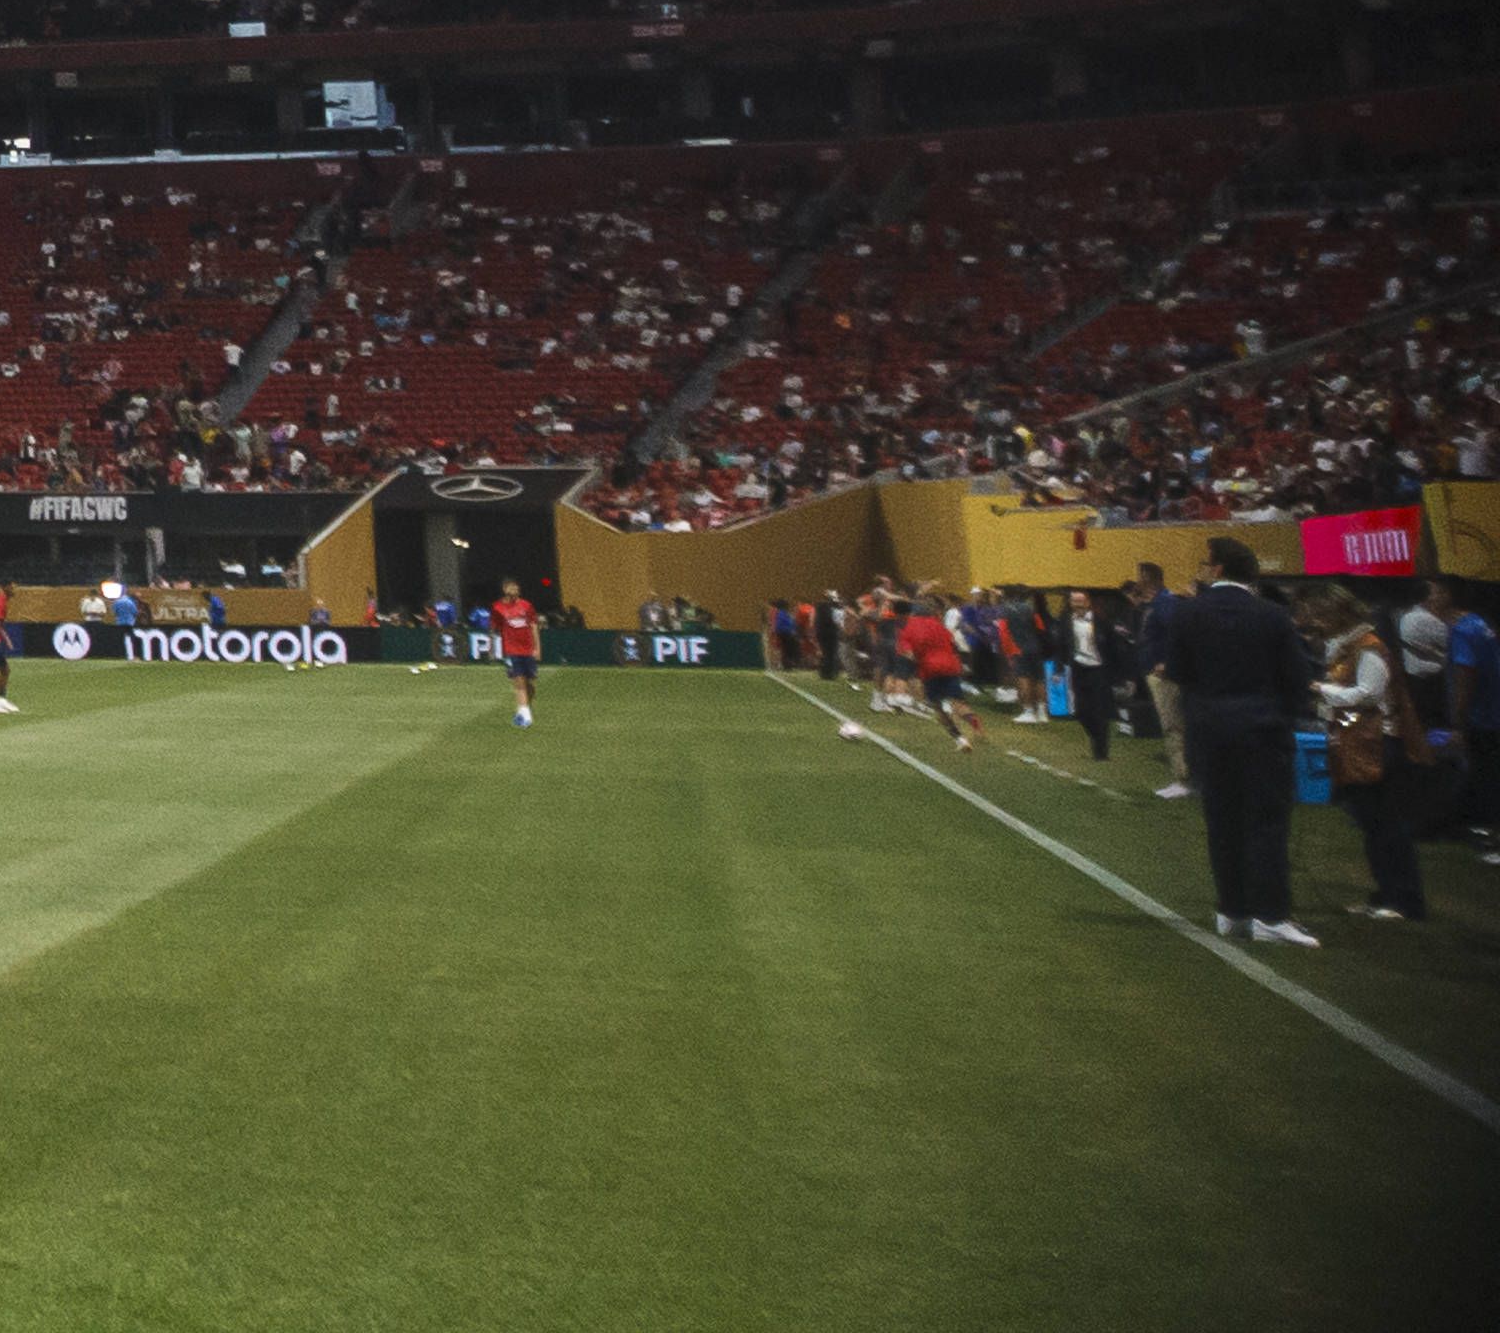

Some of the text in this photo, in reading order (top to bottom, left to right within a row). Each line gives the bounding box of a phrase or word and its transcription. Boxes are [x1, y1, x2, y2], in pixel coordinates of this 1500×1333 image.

[29, 496, 128, 521] #FIFACWC
[124, 623, 348, 664] motorola
[652, 636, 710, 664] PIF
